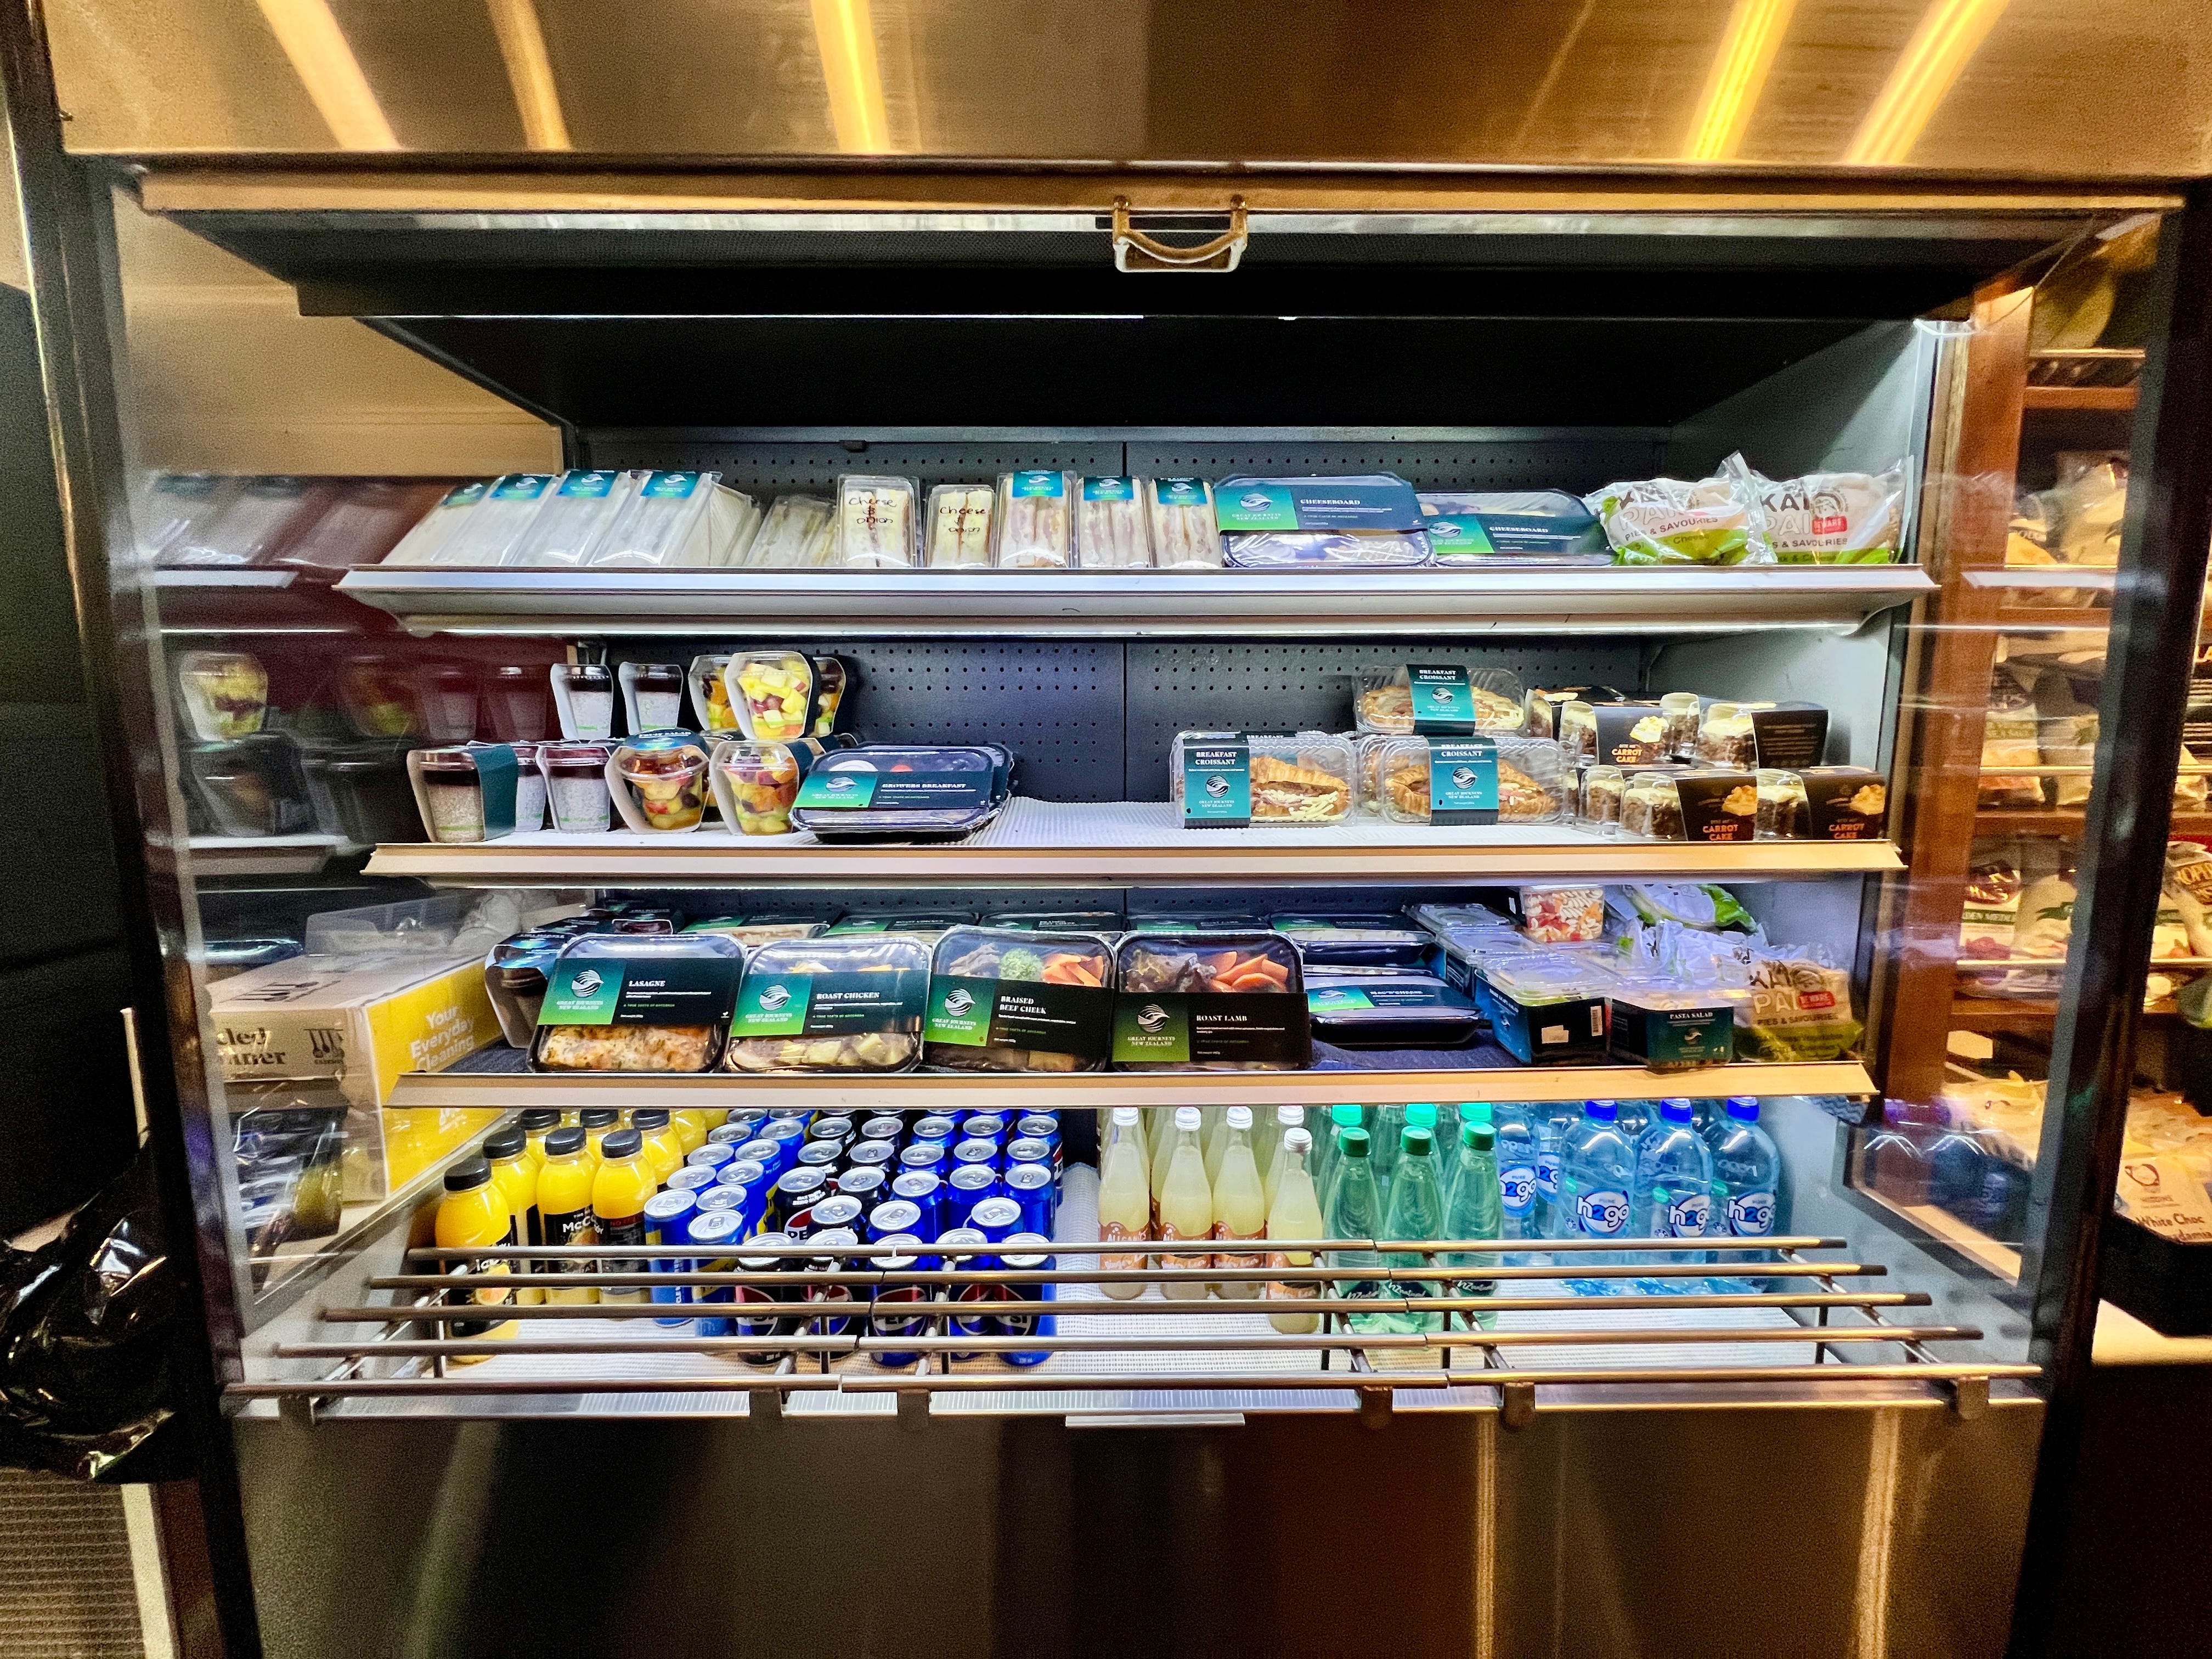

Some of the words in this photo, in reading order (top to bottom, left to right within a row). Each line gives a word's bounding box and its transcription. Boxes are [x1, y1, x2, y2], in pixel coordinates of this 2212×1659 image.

[1649, 527, 1657, 535] &
[1658, 517, 1719, 533] SAVOURIES
[1702, 825, 1739, 833] CARROT
[1709, 833, 1733, 841] CAKE
[844, 991, 881, 1000] CHICKEN
[1000, 996, 1034, 1005] BRAISED
[1753, 988, 1799, 1014] PAI
[425, 1006, 459, 1029] Your
[1020, 1006, 1047, 1014] CHEEK
[410, 1017, 475, 1059] Everyday
[416, 1035, 475, 1070] Cleaning
[1576, 1195, 1630, 1228] h2go
[1669, 1205, 1709, 1231] h2g
[2136, 1216, 2174, 1228] White
[2173, 1213, 2205, 1224] Choc
